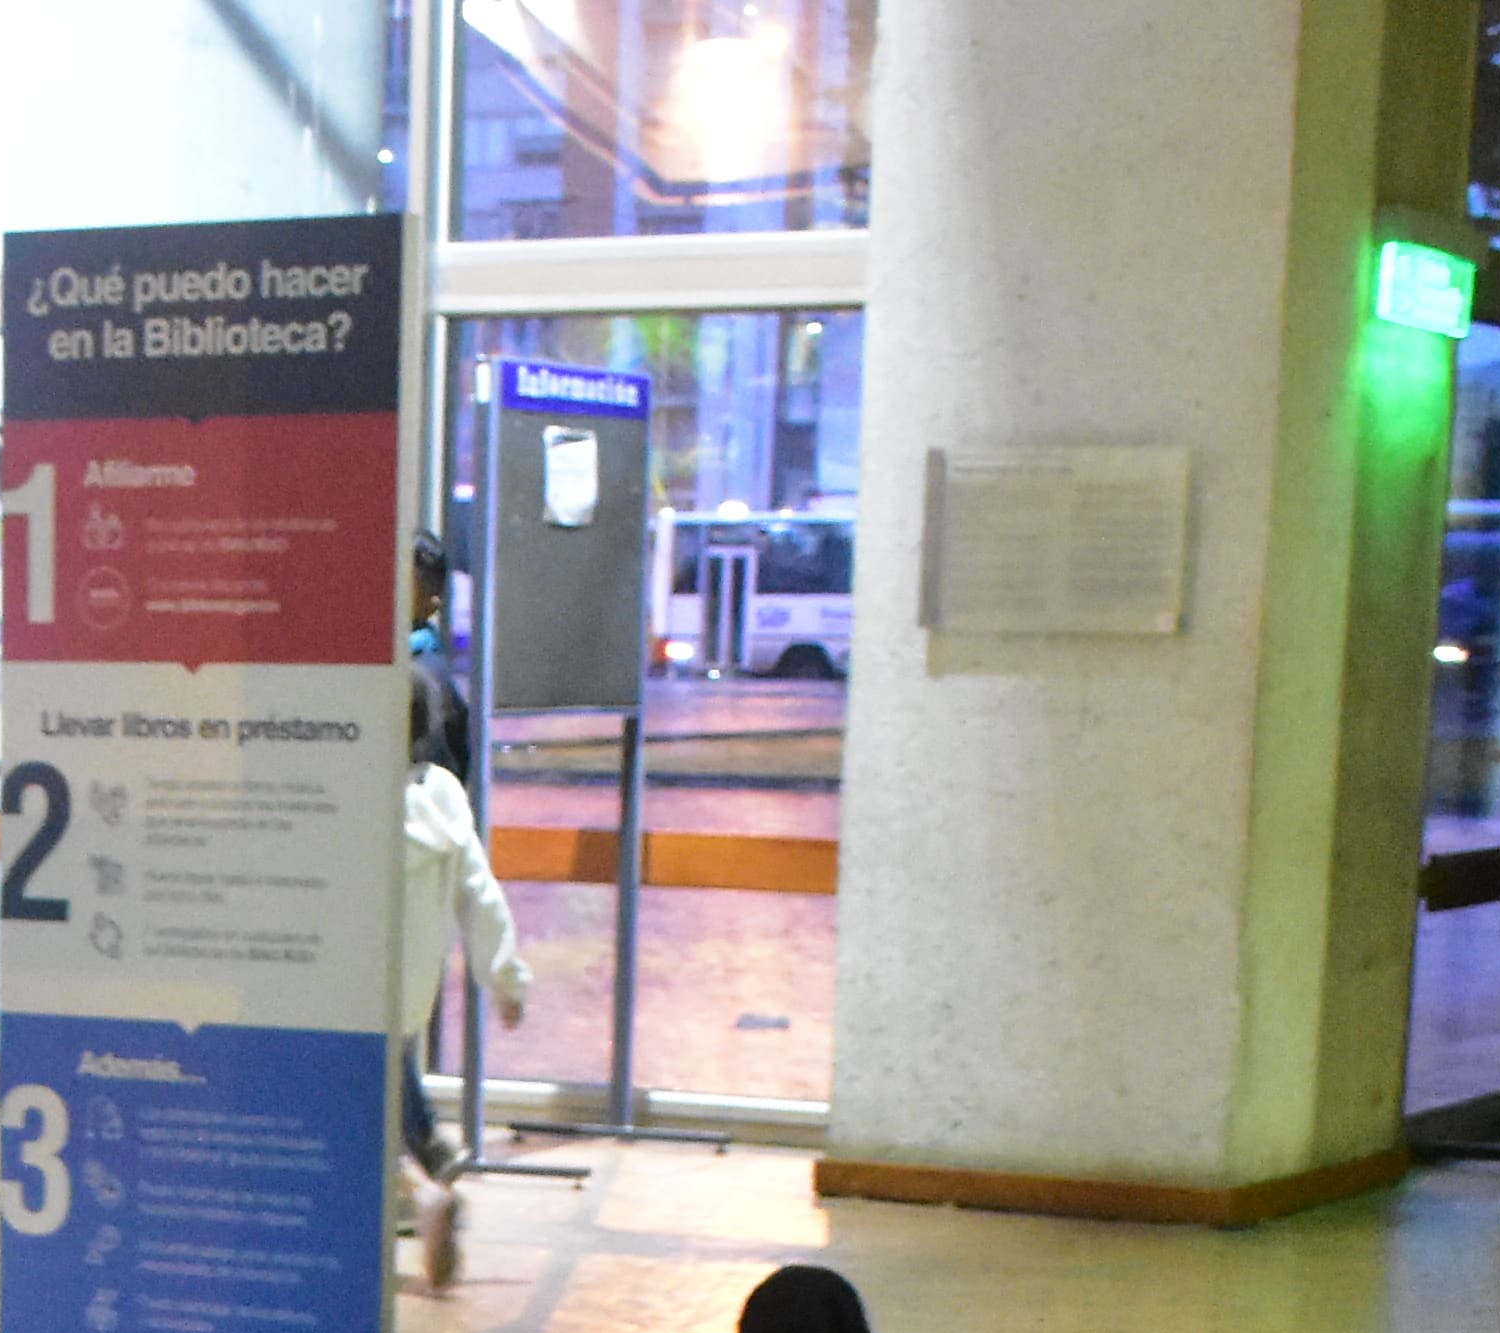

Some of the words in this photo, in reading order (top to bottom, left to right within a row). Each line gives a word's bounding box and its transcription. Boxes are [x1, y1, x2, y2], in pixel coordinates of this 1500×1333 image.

[26, 263, 126, 316] ¿Qué
[133, 261, 251, 314] puedo
[260, 259, 369, 299] hacer
[48, 327, 93, 361] en
[103, 322, 133, 358] la
[144, 311, 353, 358] Biblioteca?
[1, 463, 56, 624] 1
[40, 711, 114, 738] Llevar
[122, 712, 191, 739] libros
[199, 717, 231, 739] en
[237, 714, 361, 745] préstamo
[1, 761, 71, 922] 2
[0, 1084, 71, 1236] 3
